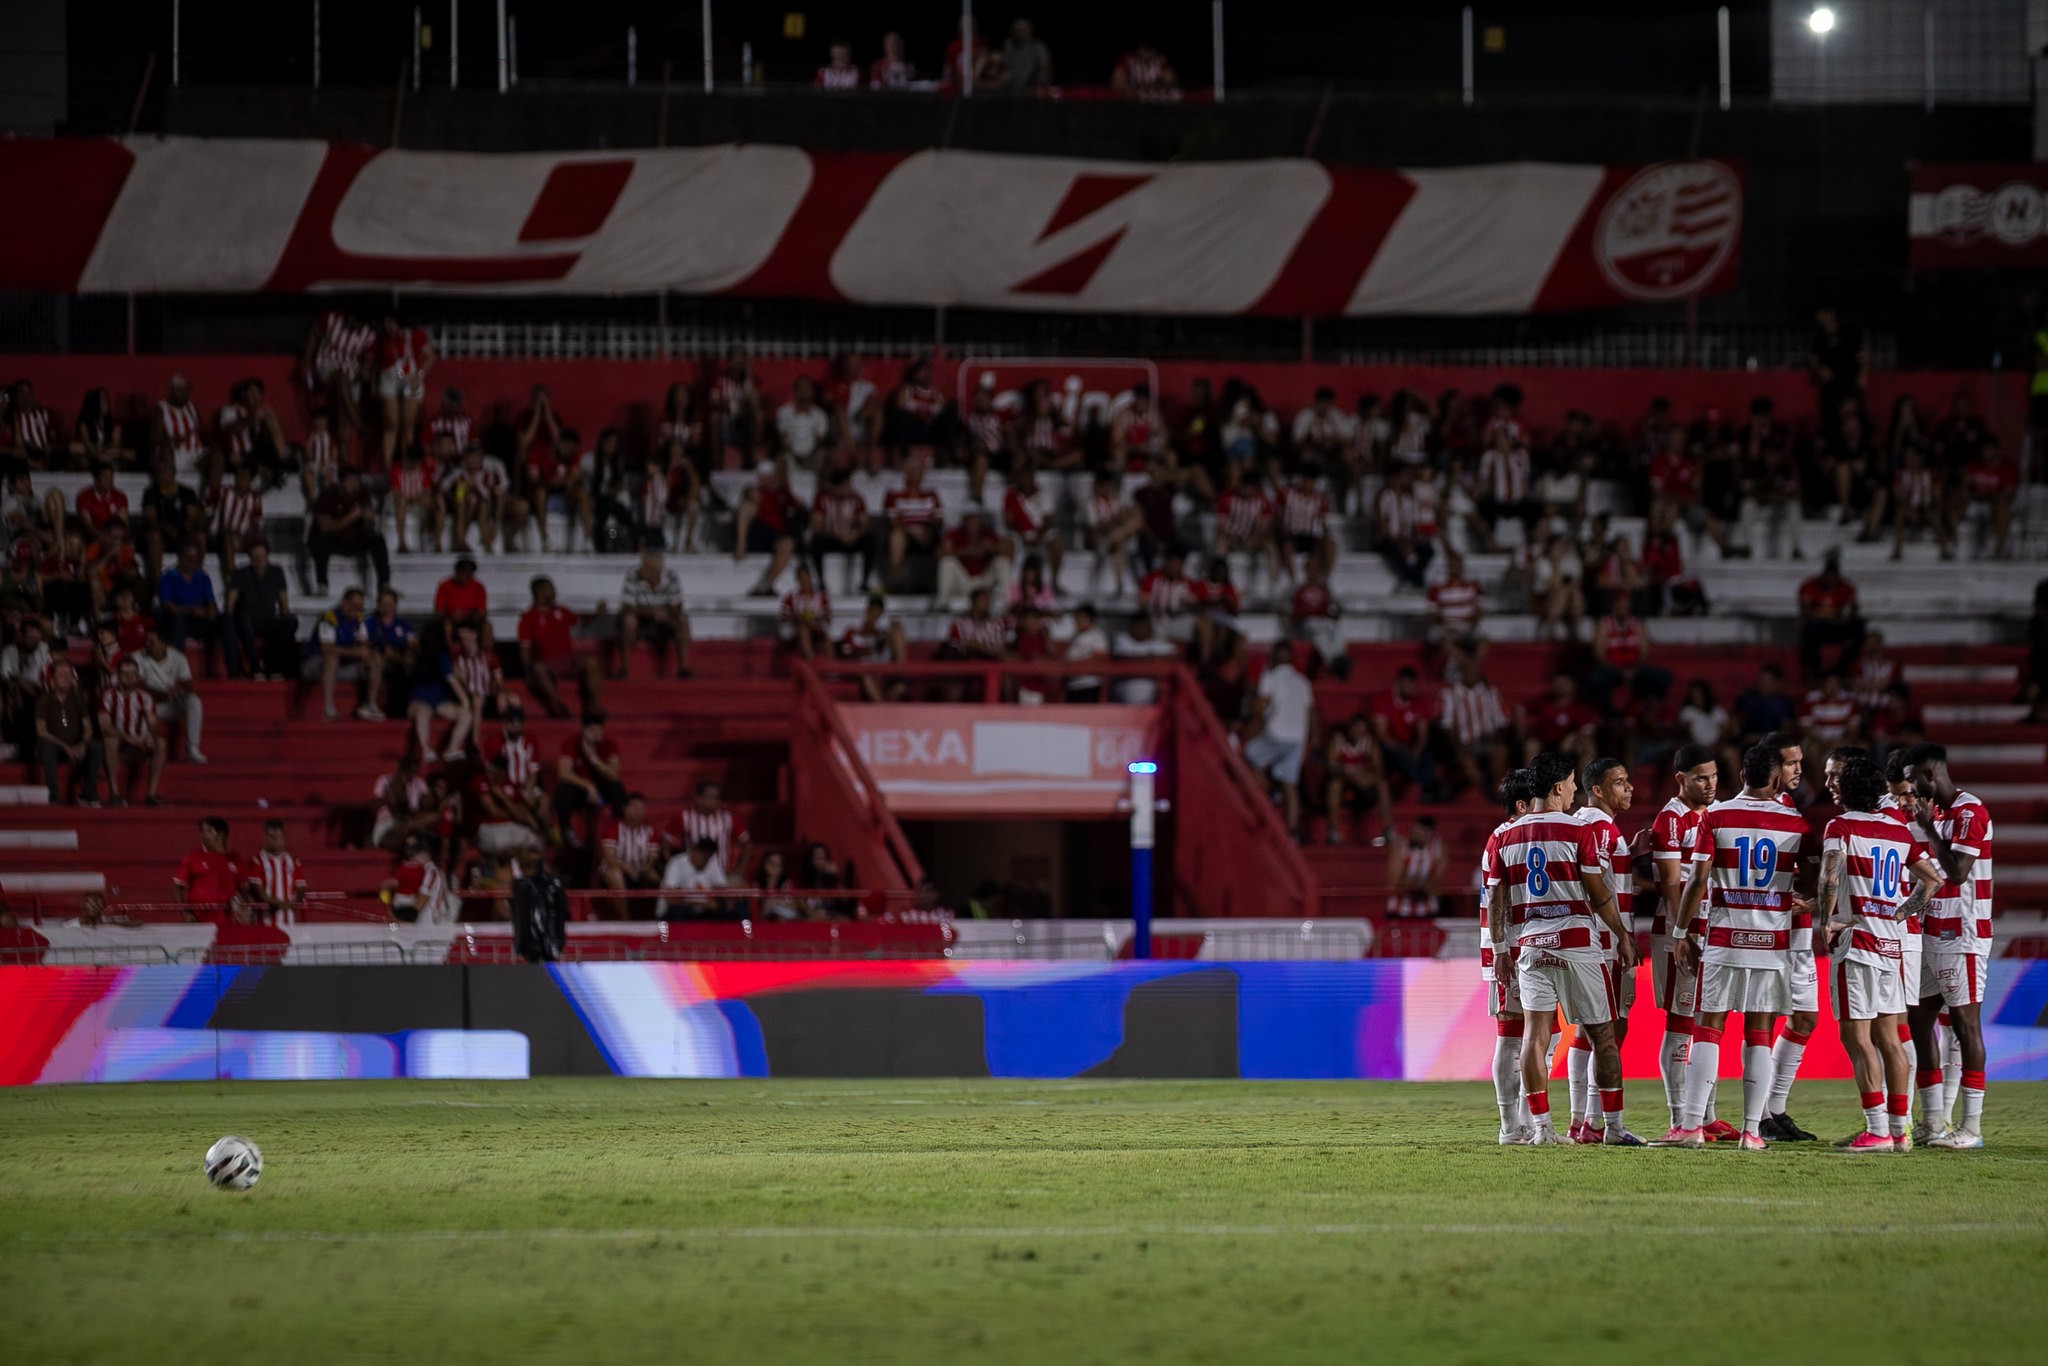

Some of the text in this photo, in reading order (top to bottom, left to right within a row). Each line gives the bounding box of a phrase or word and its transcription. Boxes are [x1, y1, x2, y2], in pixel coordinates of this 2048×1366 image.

[78, 136, 1606, 317] 1901
[1525, 846, 1551, 897] 8
[1734, 834, 1778, 888] 19
[1870, 846, 1900, 899] 10
[1535, 934, 1558, 946] RECIFE
[1748, 934, 1772, 943] RECIFE
